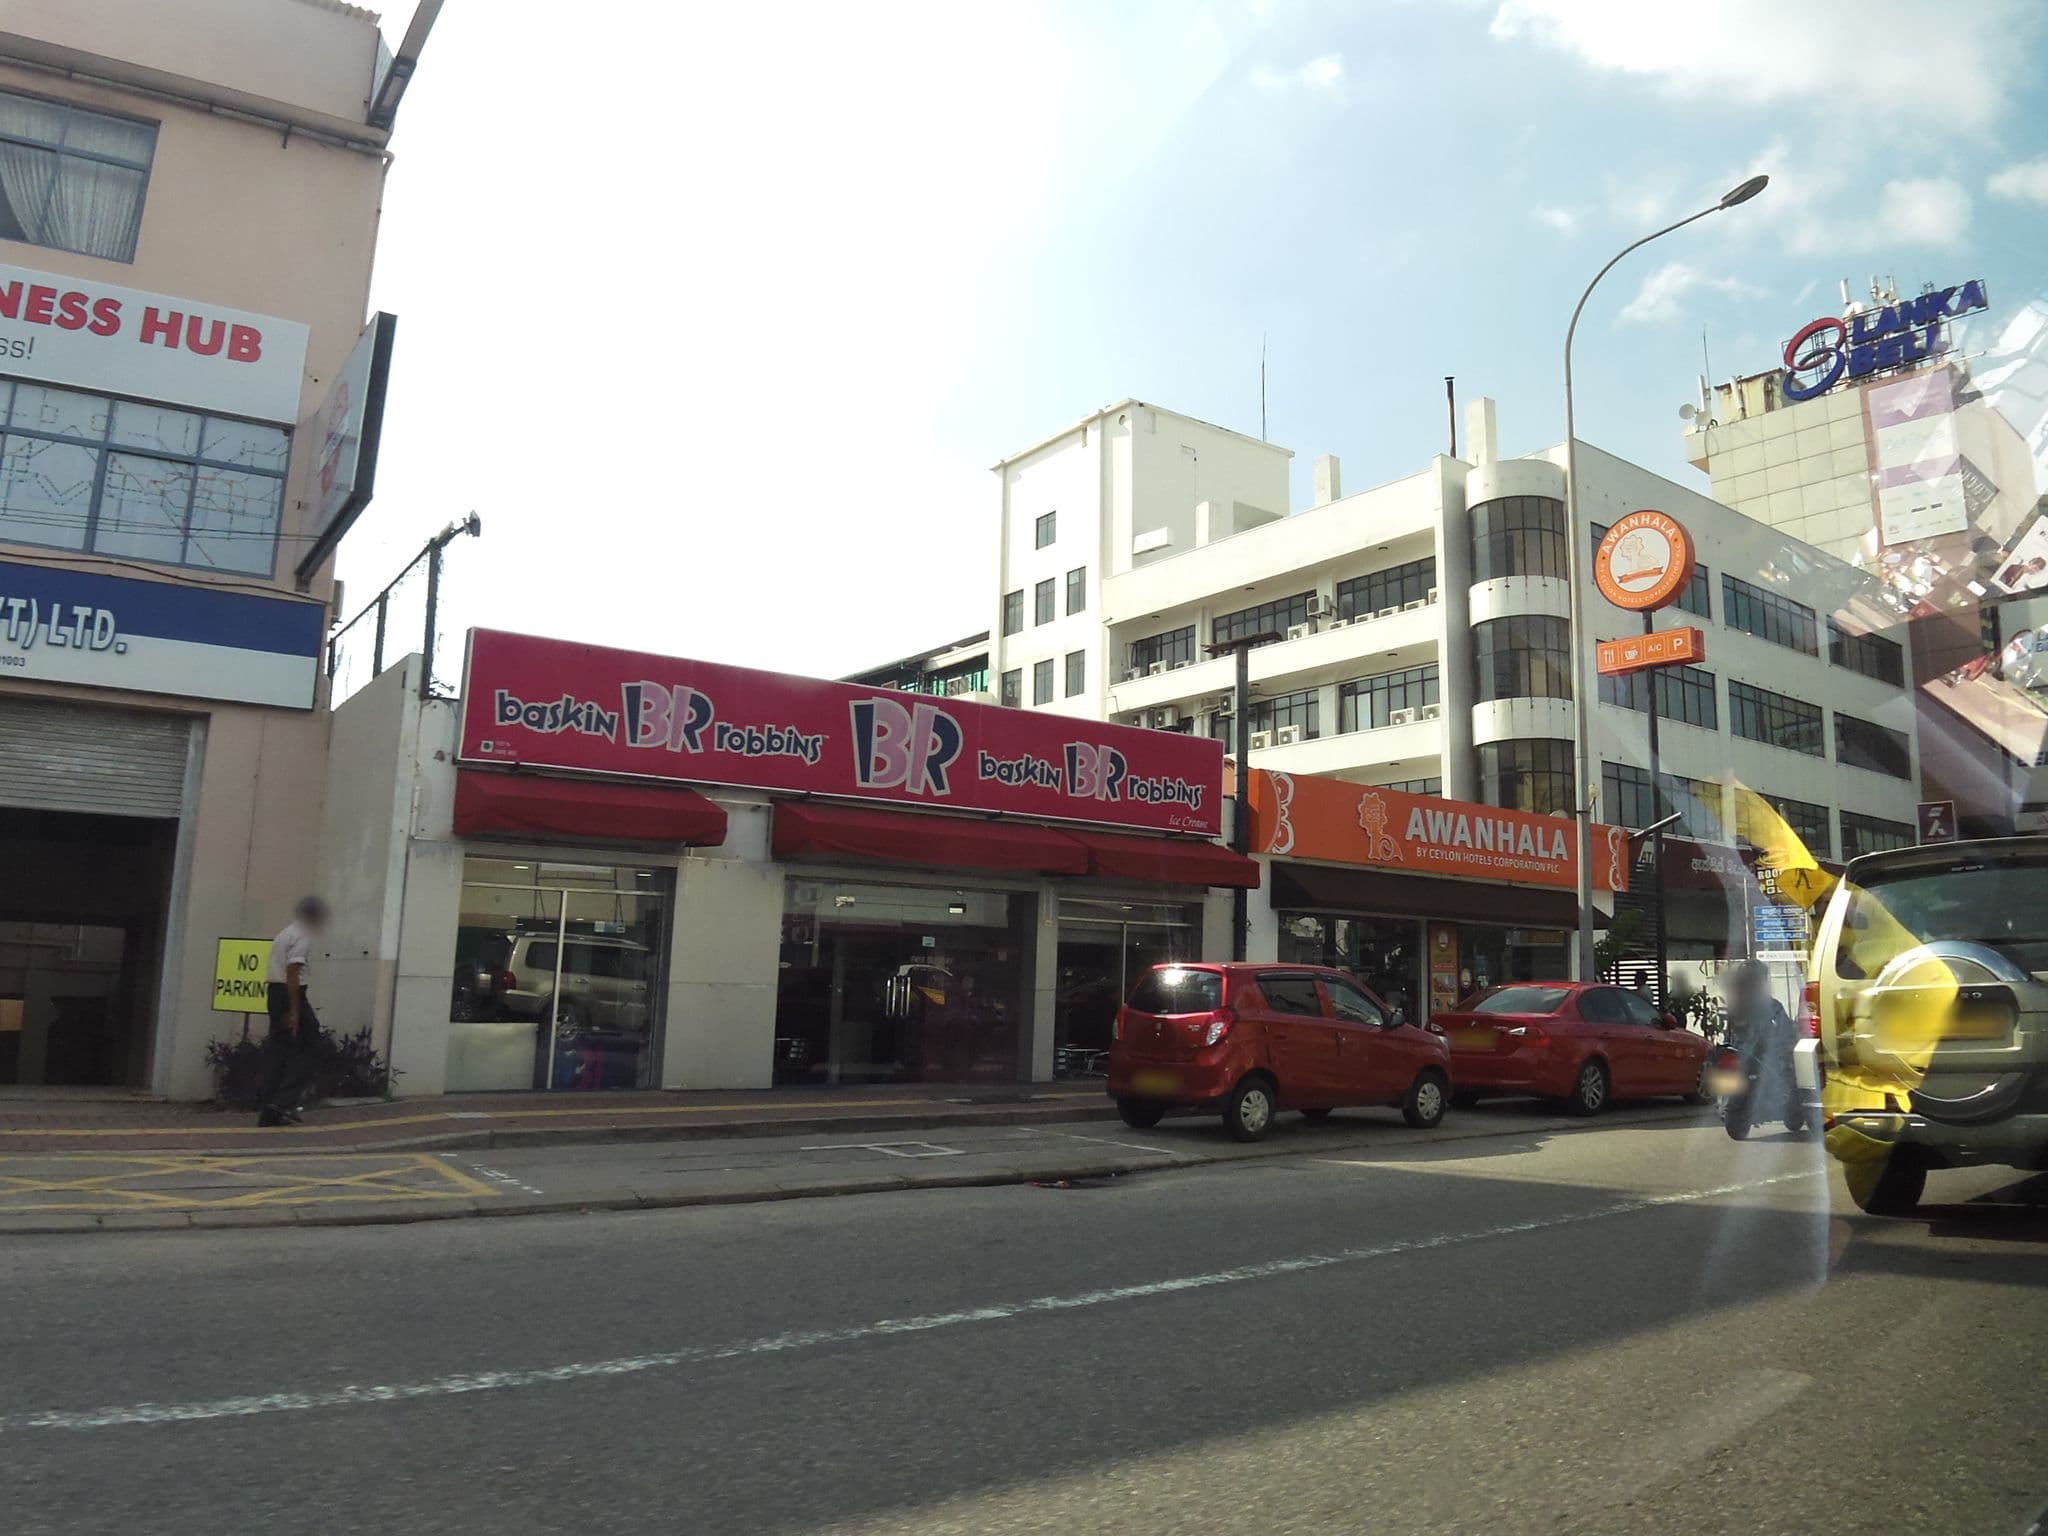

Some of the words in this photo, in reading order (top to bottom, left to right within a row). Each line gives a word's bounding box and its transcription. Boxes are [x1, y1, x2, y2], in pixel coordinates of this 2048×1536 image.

[1852, 279, 1987, 346] LANKA
[139, 306, 263, 363] HUB
[1602, 514, 1676, 554] AWANHALA
[0, 596, 39, 650] T)
[47, 603, 128, 655] LTD.
[1673, 637, 1684, 651] P
[1648, 643, 1662, 652] A/C
[495, 689, 619, 744] baskin
[621, 680, 714, 753] BR
[714, 722, 824, 764] robbins
[849, 697, 963, 796] BR
[978, 749, 1062, 793] baskin
[1064, 740, 1127, 801] BR
[1127, 775, 1203, 811] robbins
[1169, 814, 1180, 825] Ice
[1405, 807, 1568, 860] AWANHALA
[1416, 847, 1427, 857] BY
[1430, 848, 1461, 862] CEYLON
[1463, 855, 1492, 866] HOTELS
[1494, 856, 1546, 872] CORPORATION
[1547, 863, 1560, 873] PLC
[1757, 868, 1783, 879] ROO
[238, 954, 259, 971] NO
[216, 979, 268, 997] PARKIN
